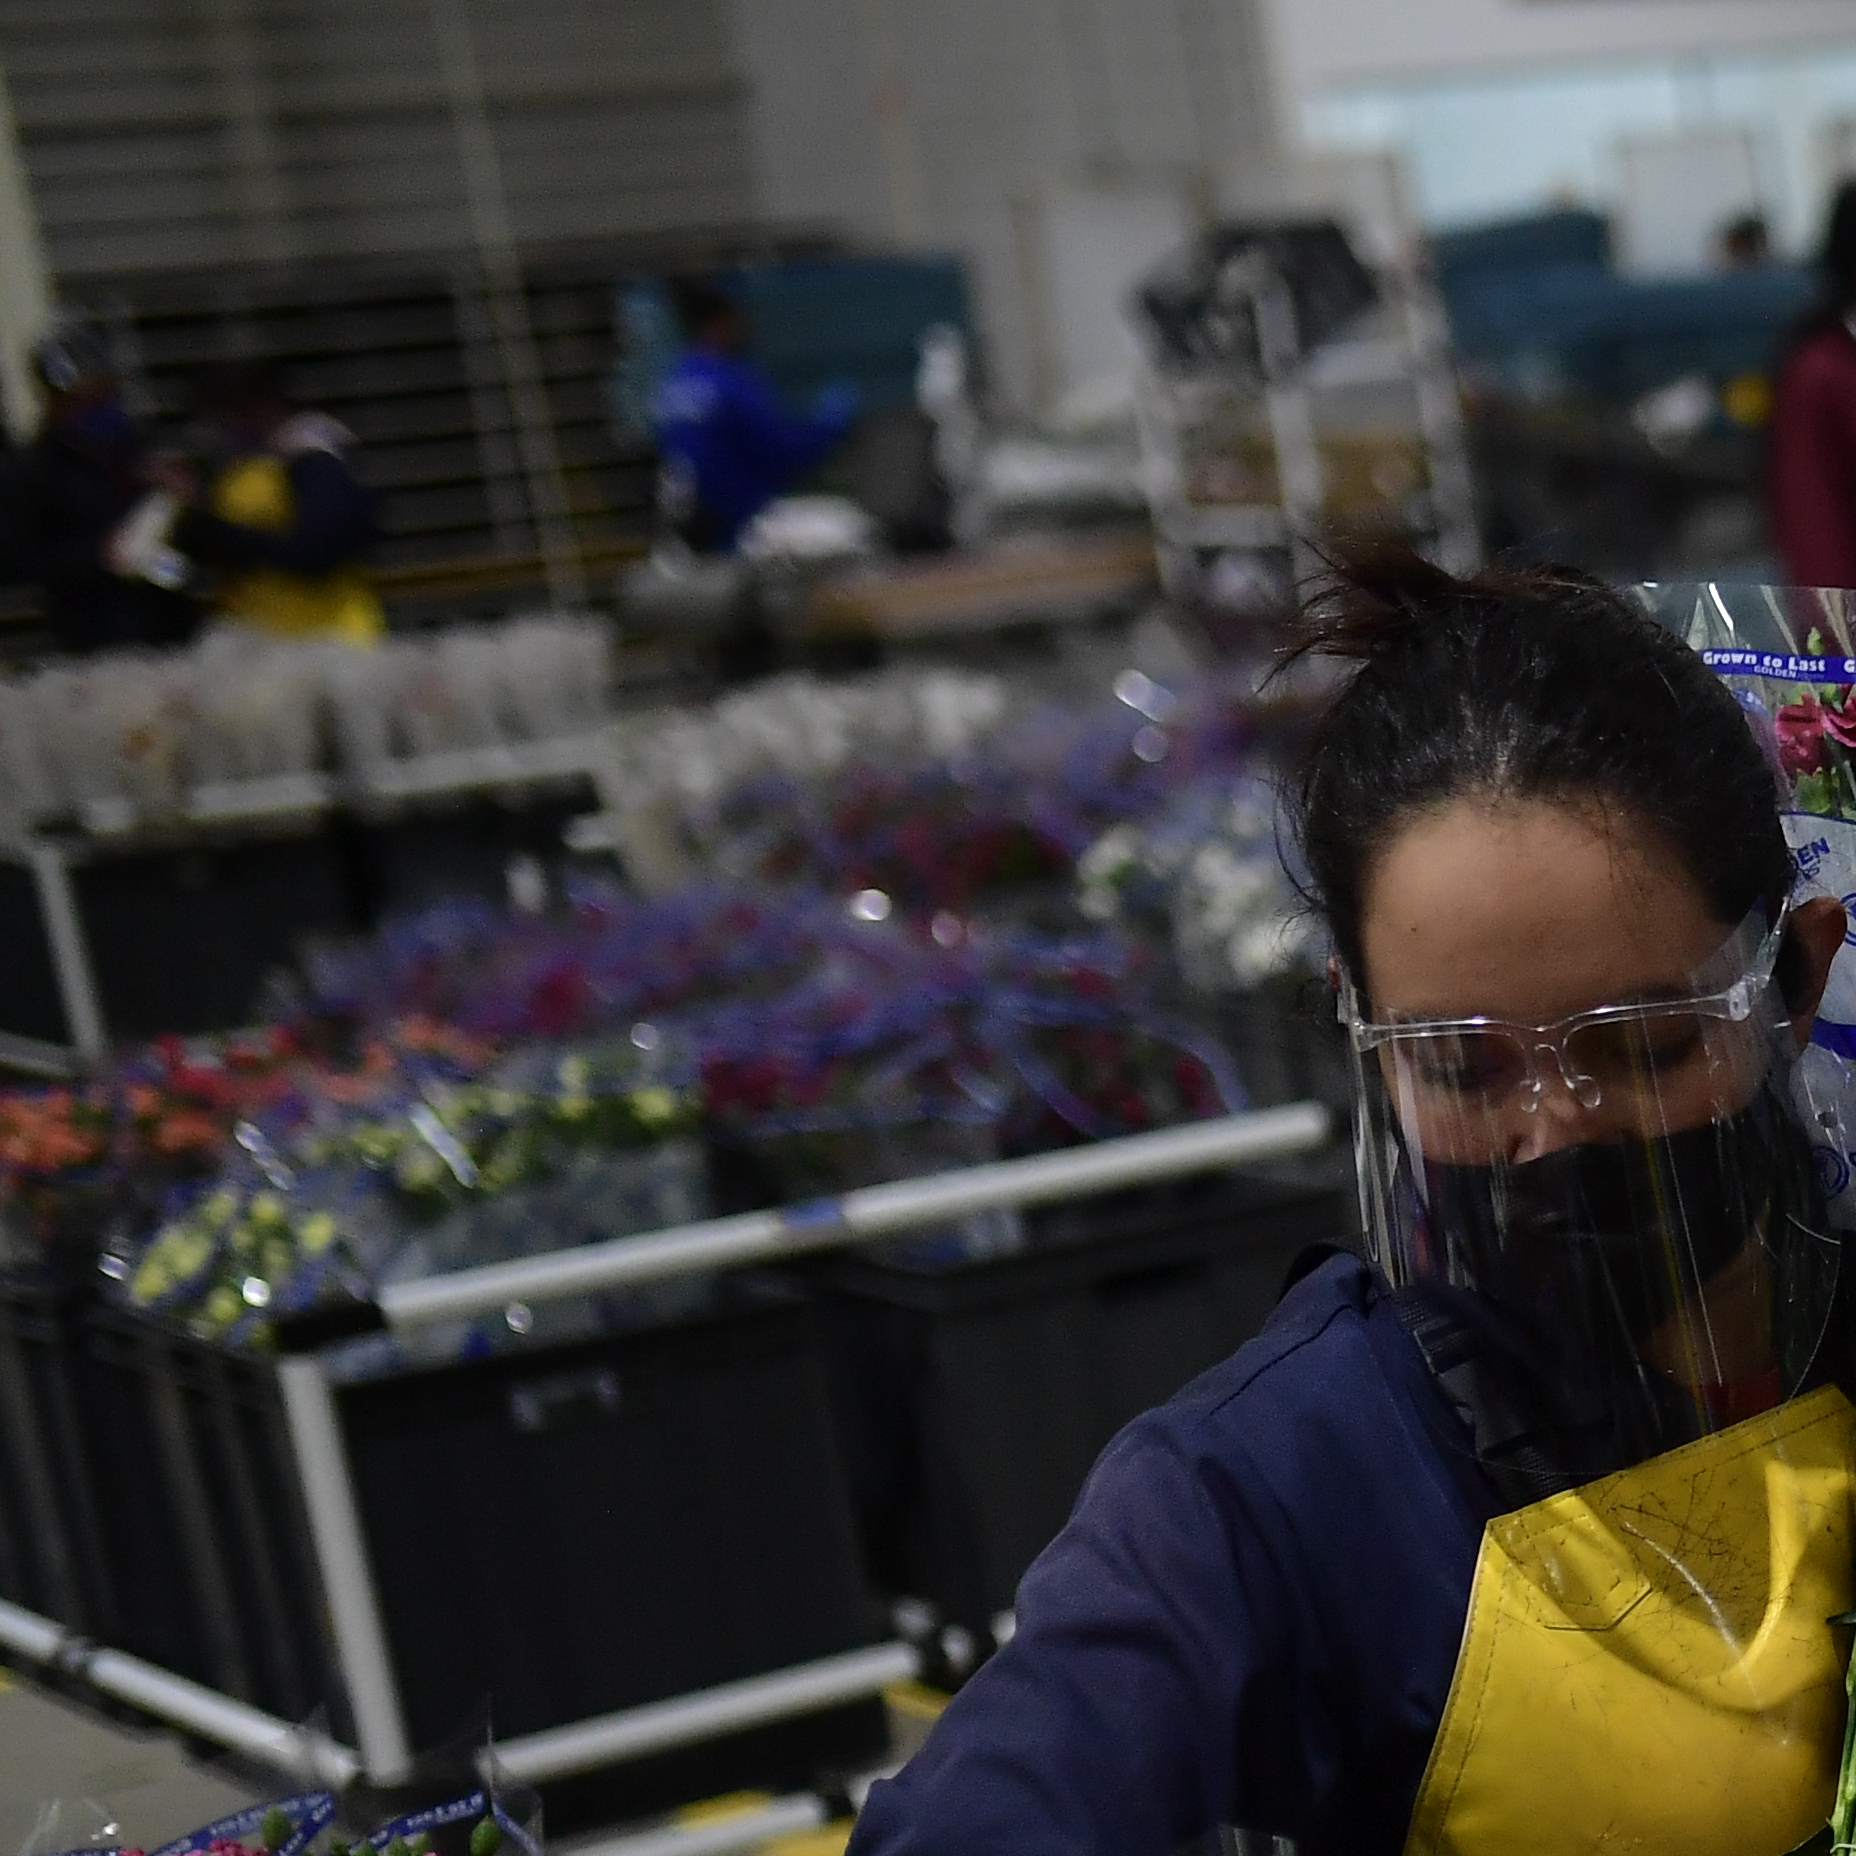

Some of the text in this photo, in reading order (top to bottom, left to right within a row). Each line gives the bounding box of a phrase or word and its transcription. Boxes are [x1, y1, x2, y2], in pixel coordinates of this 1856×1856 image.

[1702, 651, 1757, 665] Grown
[1763, 654, 1783, 668] to
[1788, 656, 1826, 672] Last
[1753, 665, 1797, 679] GOLDEN
